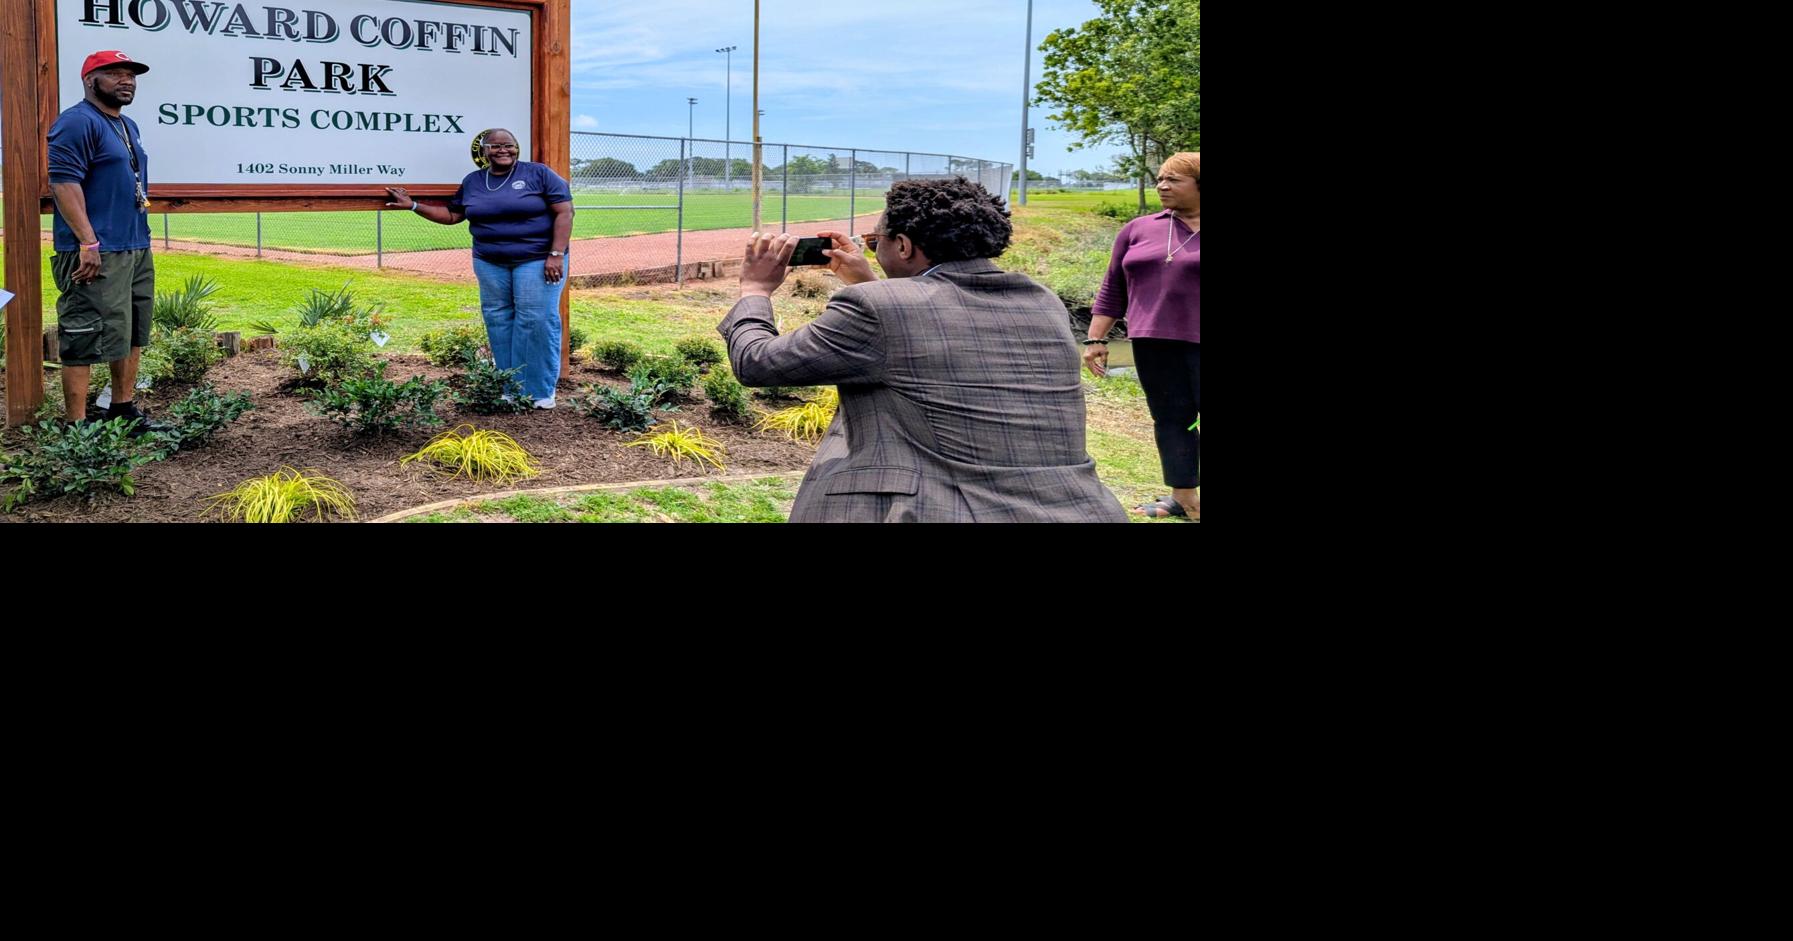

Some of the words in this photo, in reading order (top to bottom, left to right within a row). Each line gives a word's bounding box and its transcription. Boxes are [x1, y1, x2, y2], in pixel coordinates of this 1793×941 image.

[79, 0, 340, 43] HOWARD
[350, 14, 520, 58] COFFIN
[249, 56, 397, 96] PARK
[158, 103, 300, 129] SPORTS
[310, 109, 465, 134] COMPLEX
[236, 163, 274, 174] 1402
[278, 163, 324, 177] Sonny
[330, 164, 373, 176] Miller
[377, 165, 406, 177] Way
